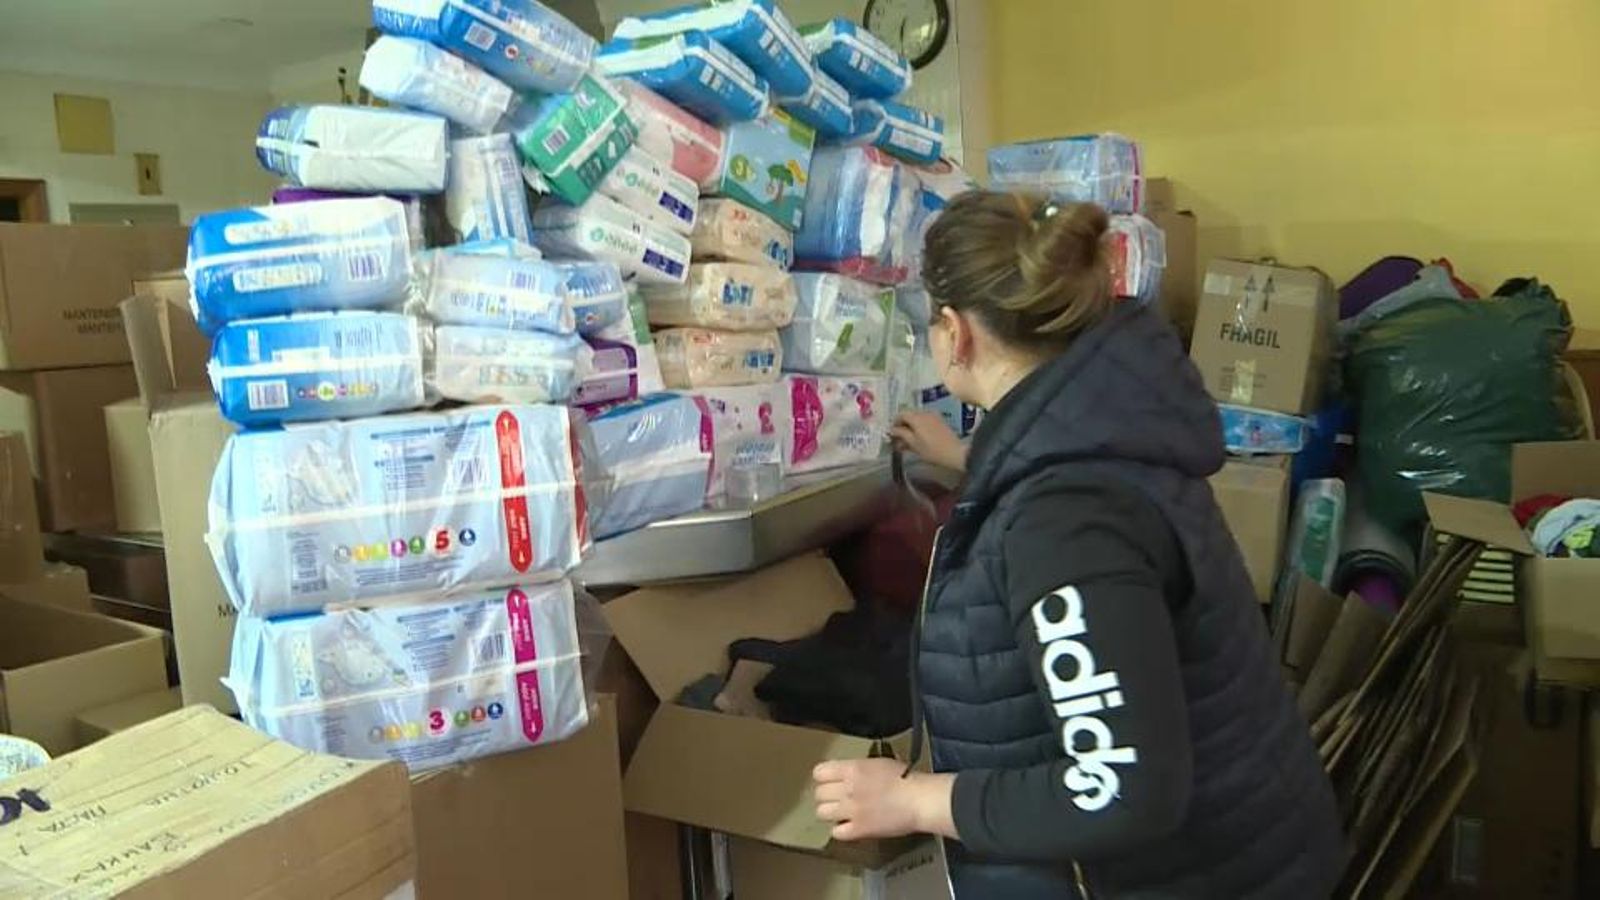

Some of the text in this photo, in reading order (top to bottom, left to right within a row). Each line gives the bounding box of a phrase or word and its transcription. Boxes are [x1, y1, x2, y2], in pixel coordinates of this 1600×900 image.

[435, 530, 450, 550] 5
[1031, 585, 1138, 811] adids
[429, 710, 445, 730] 3
